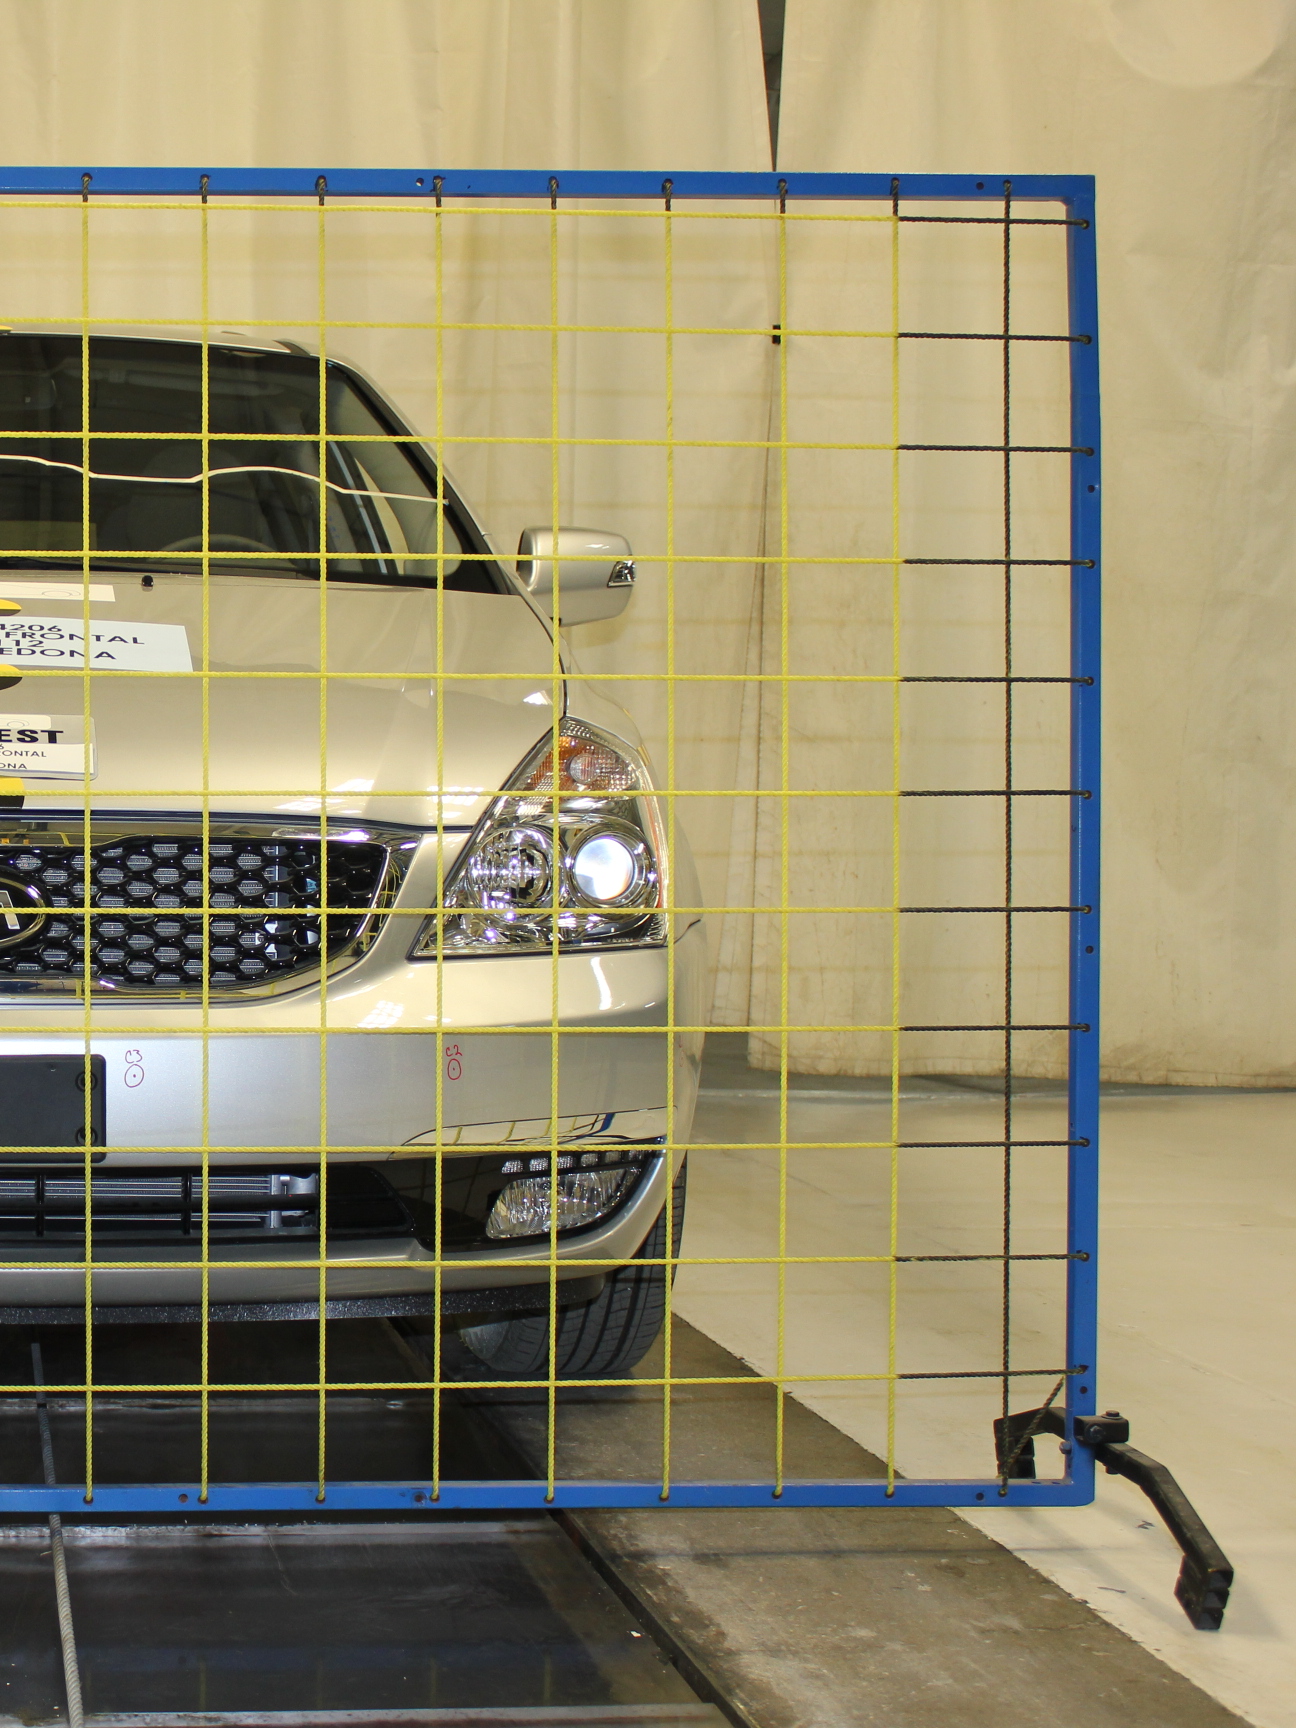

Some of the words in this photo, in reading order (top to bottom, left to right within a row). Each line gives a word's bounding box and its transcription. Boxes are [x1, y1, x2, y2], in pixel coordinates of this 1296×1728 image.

[4, 631, 145, 645] FRONTAL
[125, 1049, 143, 1064] C3
[445, 1044, 463, 1057] C2
